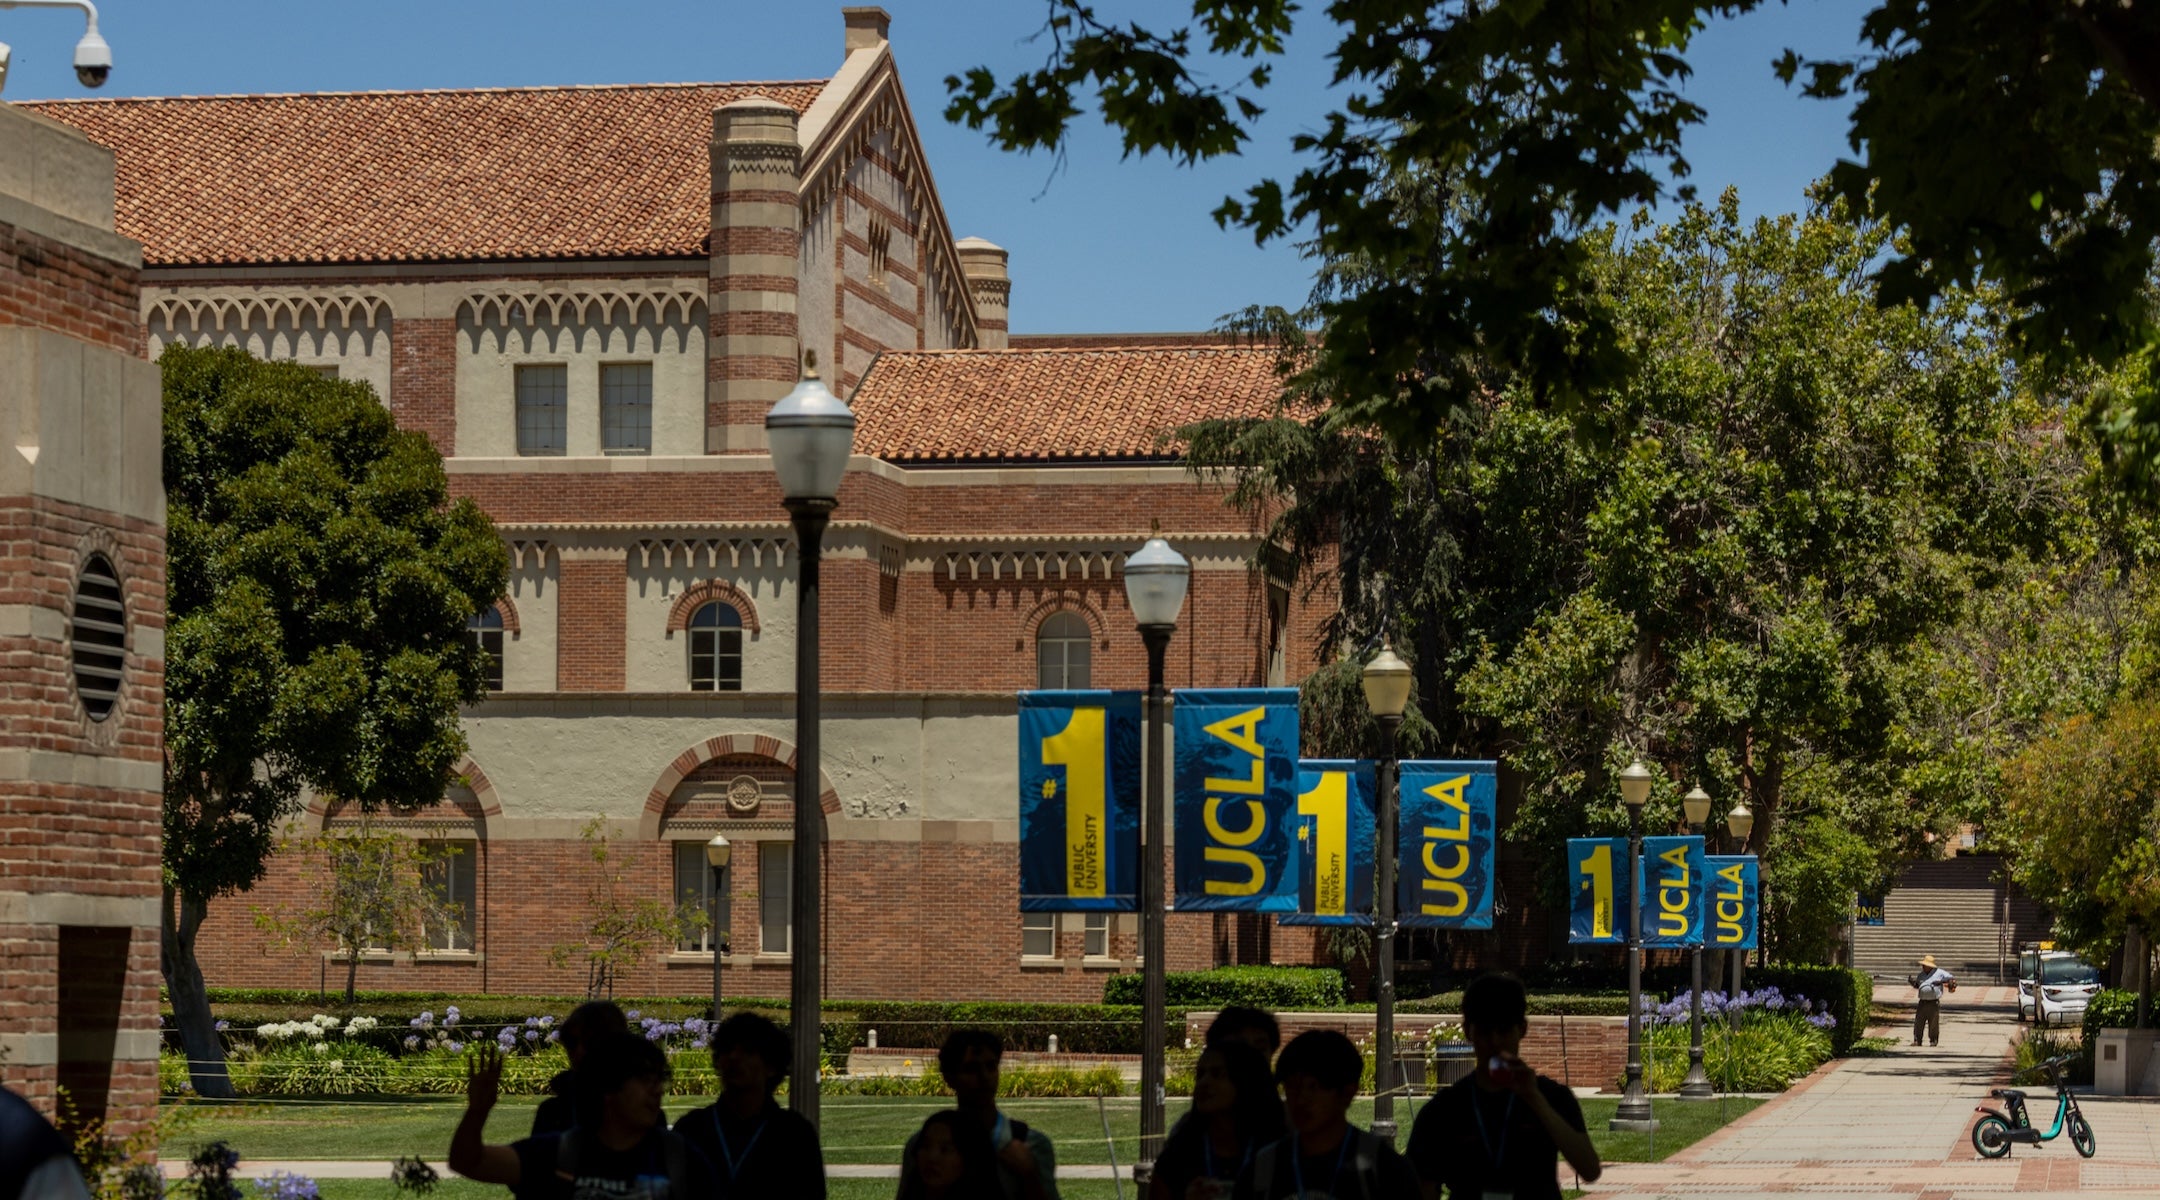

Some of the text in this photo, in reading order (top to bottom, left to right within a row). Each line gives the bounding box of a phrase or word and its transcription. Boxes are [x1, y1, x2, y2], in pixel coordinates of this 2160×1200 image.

[1203, 706, 1266, 896] UCLA
[1072, 844, 1085, 889] PUBLIC
[1085, 814, 1098, 891] UNIVERSITY
[1330, 852, 1341, 910] UNIVERSITY
[1422, 774, 1470, 916] UCLA
[1320, 875, 1330, 909] PUBLIC
[1658, 844, 1690, 937] UCLA
[1716, 863, 1744, 943] UCLA
[2017, 1106, 2028, 1126] veo
